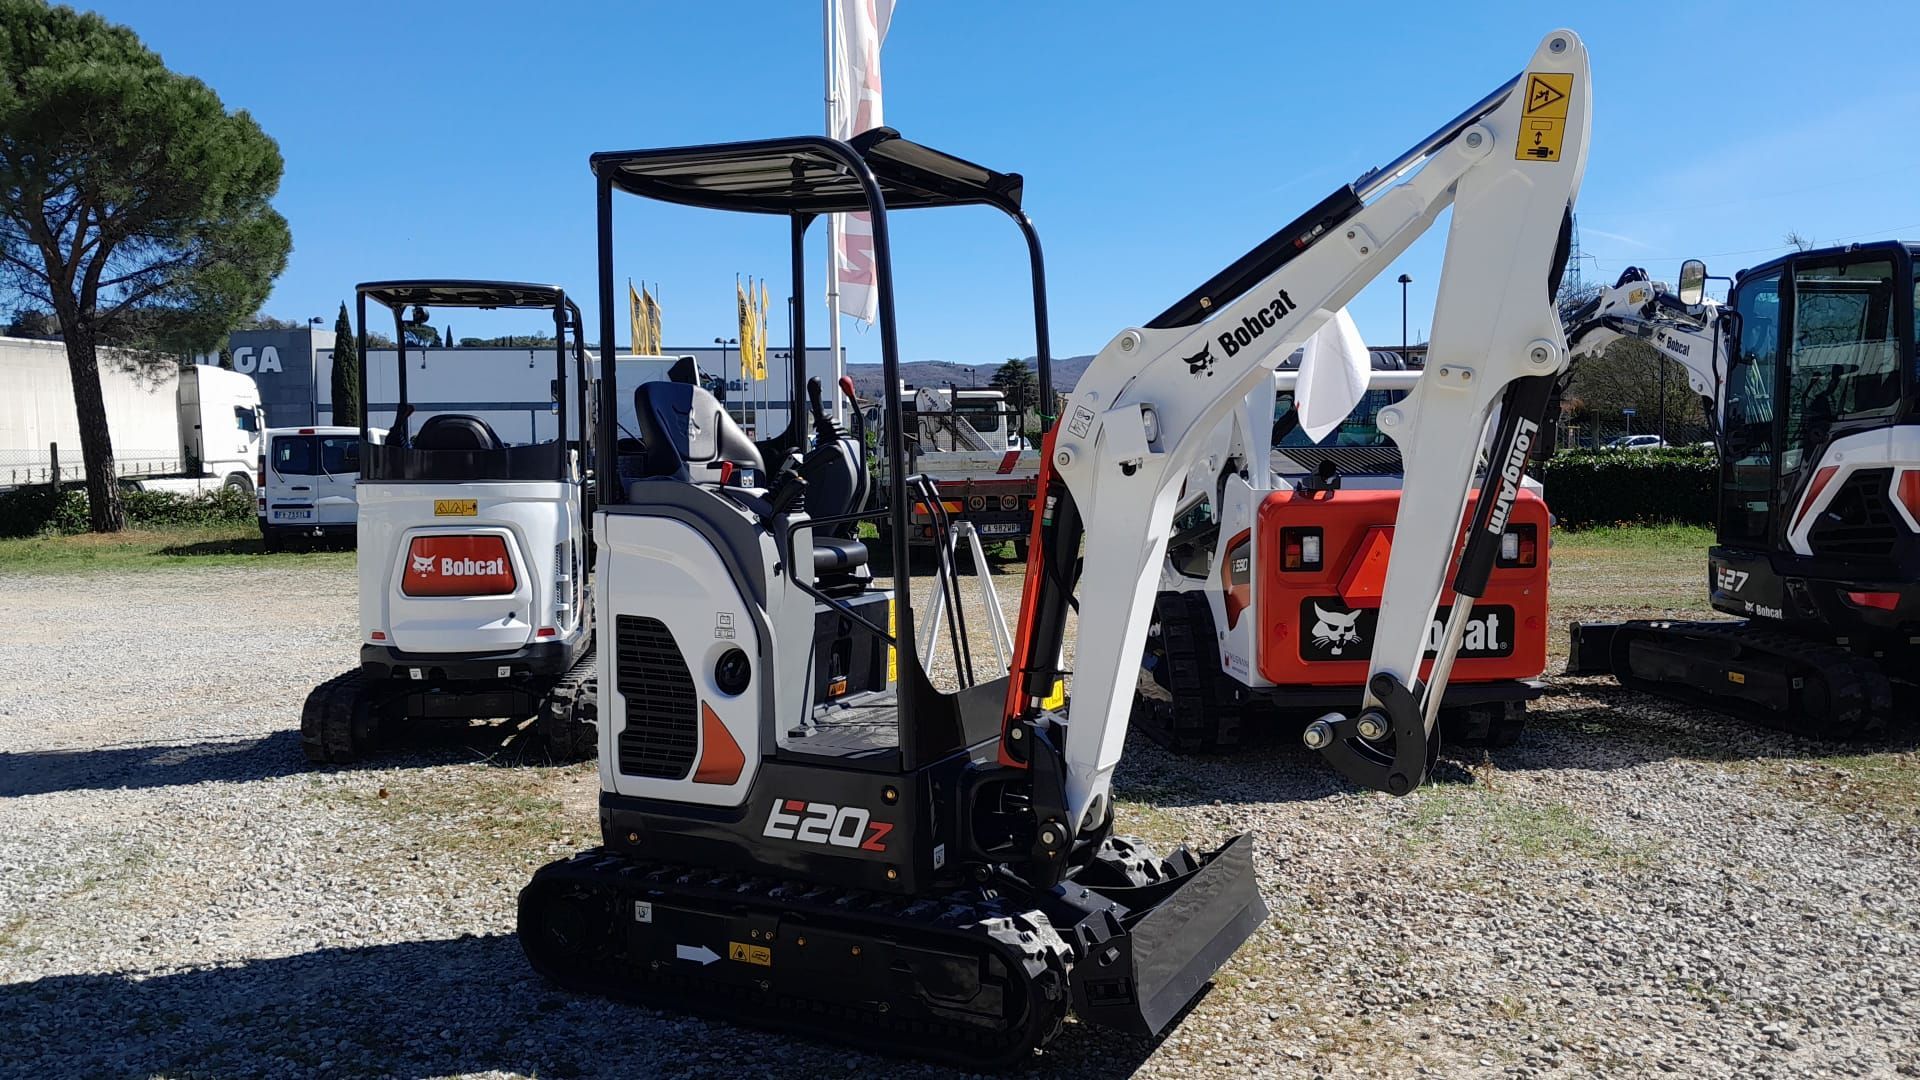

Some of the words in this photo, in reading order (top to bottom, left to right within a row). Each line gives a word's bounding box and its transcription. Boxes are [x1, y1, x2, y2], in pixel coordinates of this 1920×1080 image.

[1217, 288, 1297, 358] Bobcat
[1666, 337, 1690, 357] Bobcat
[1488, 416, 1539, 535] LongArm
[441, 557, 504, 576] Bobcat
[1717, 567, 1749, 592] E27
[1756, 605, 1783, 619] Bobcat
